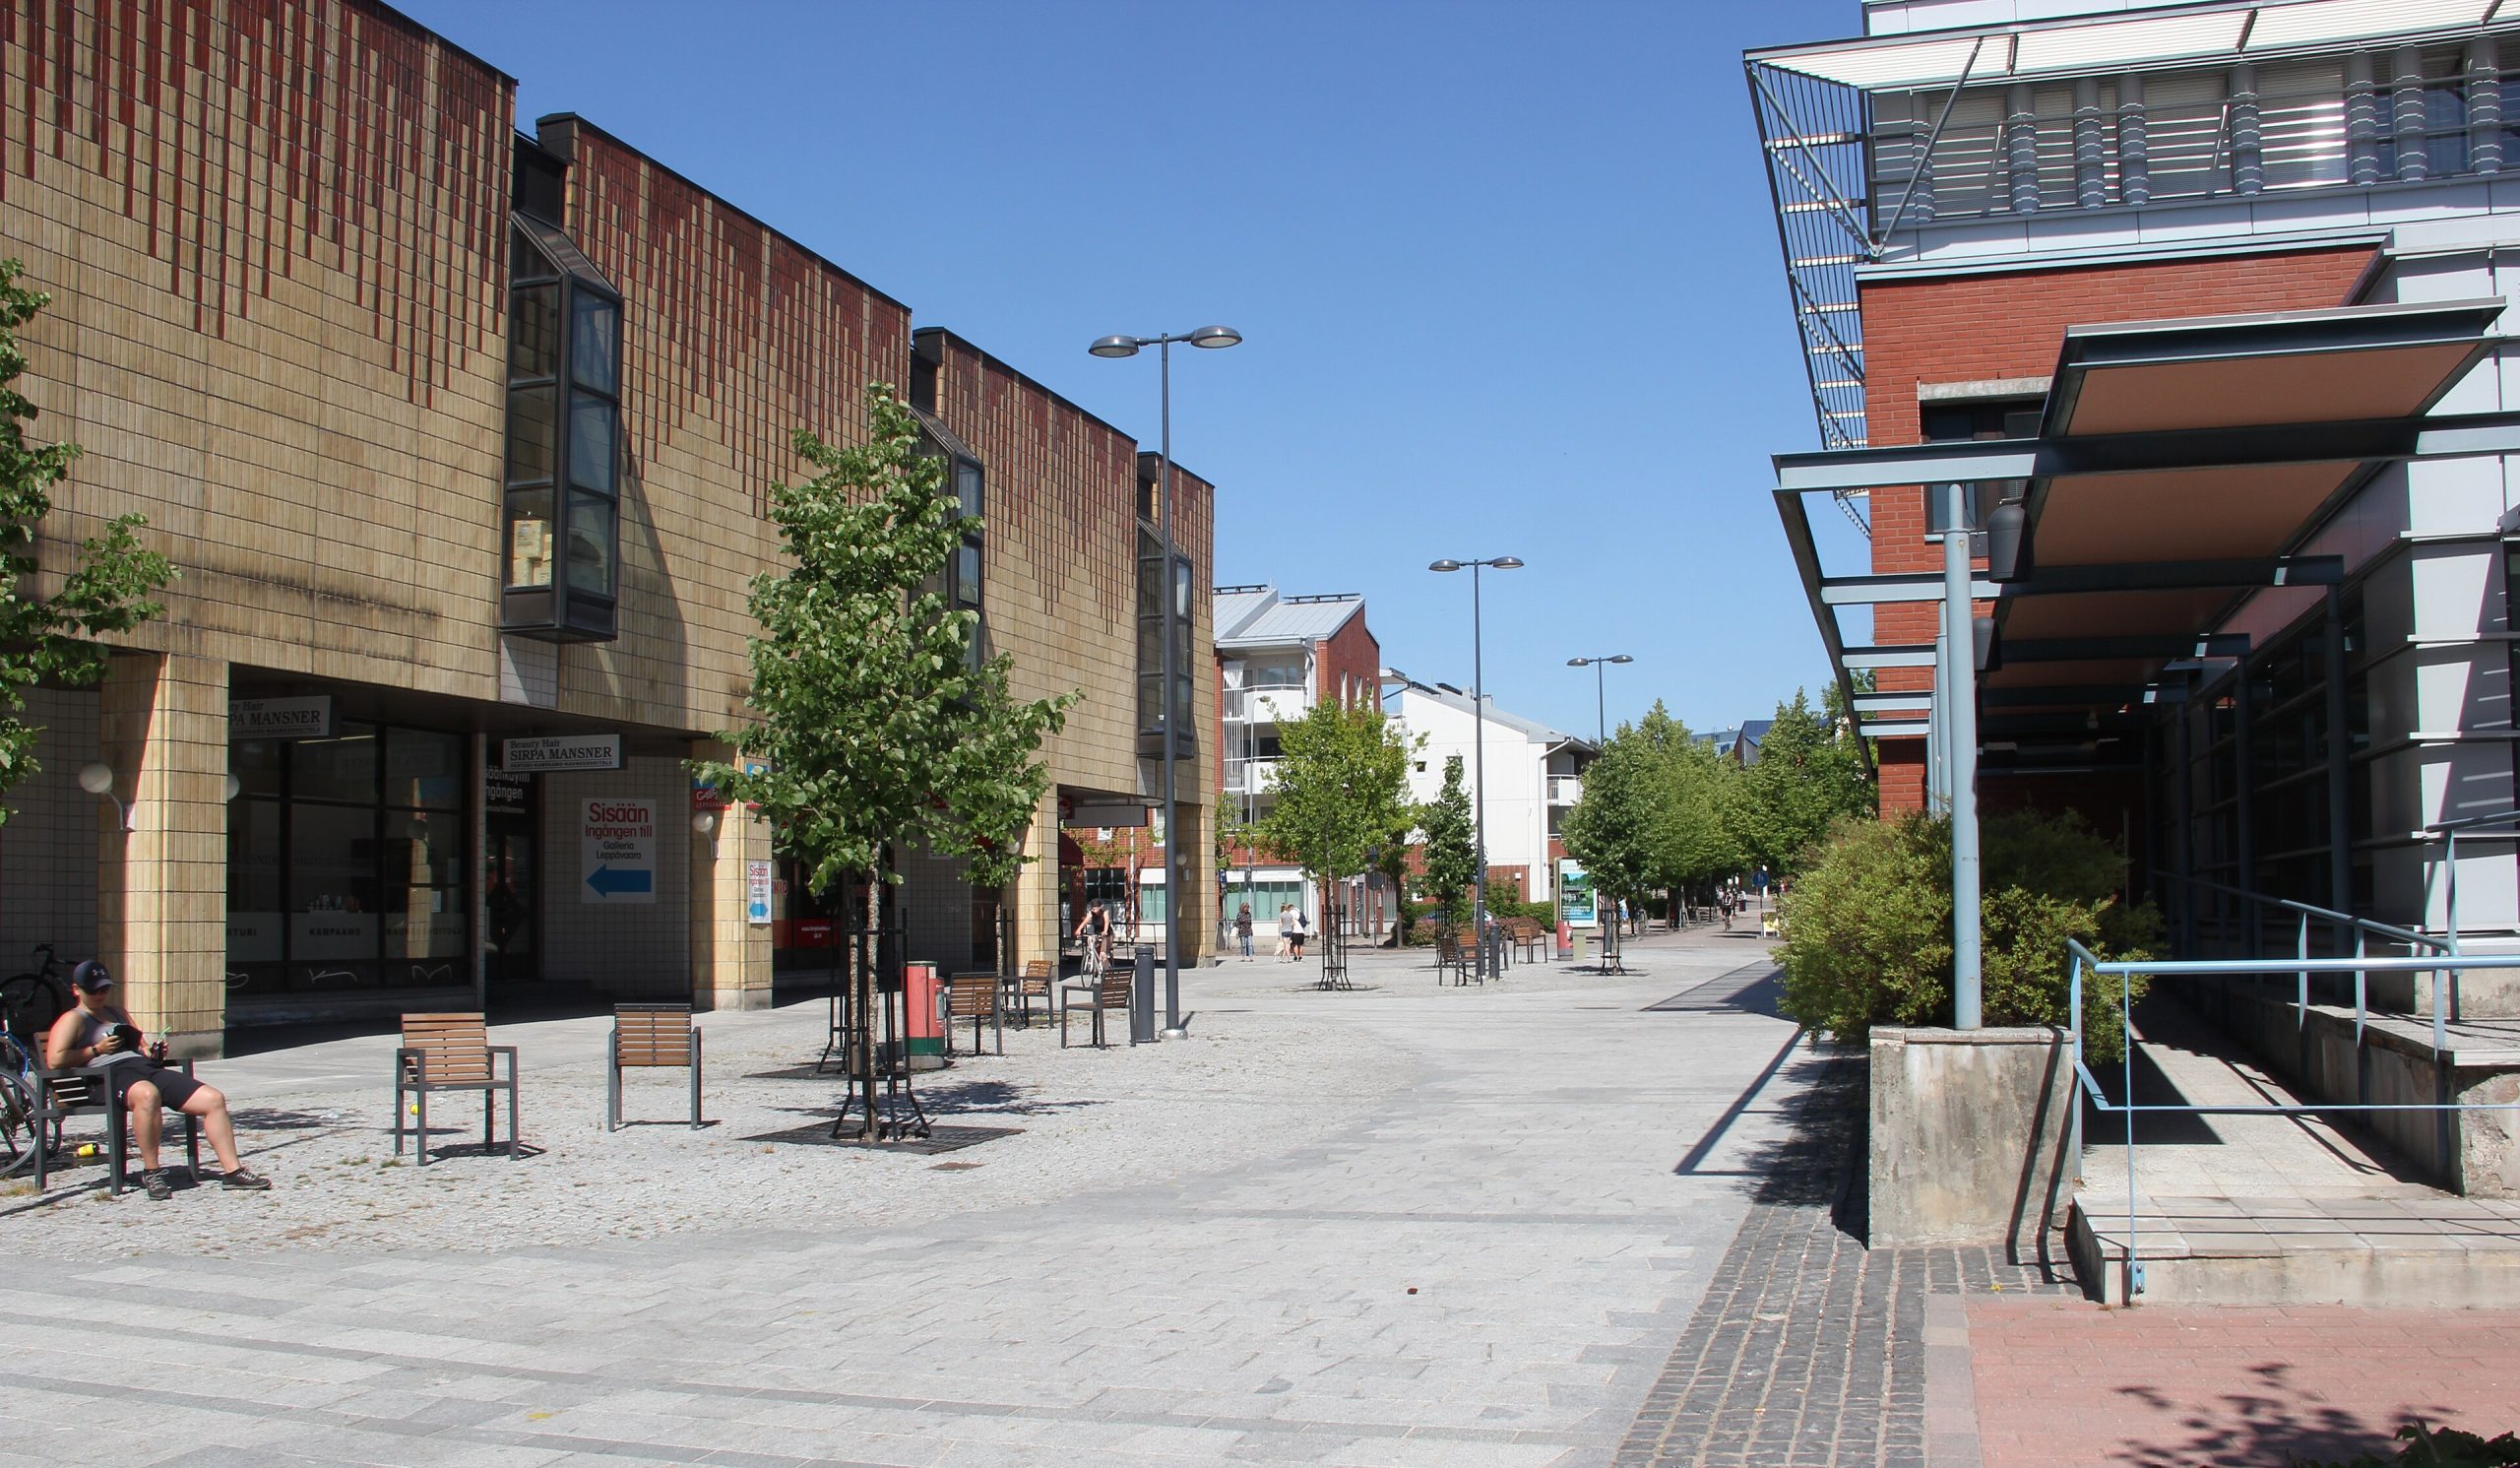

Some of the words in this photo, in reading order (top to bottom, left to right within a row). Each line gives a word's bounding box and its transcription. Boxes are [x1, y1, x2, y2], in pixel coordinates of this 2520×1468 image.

[242, 701, 265, 711] Hair
[250, 710, 321, 726] MANSNER
[510, 740, 540, 750] Beauty
[541, 738, 561, 748] Hair
[510, 749, 545, 761] SIRPA
[549, 746, 612, 760] MANSNER
[486, 782, 524, 801] ngången
[589, 802, 649, 823] Sisään
[585, 823, 637, 841] Ingången
[640, 825, 653, 838] till
[603, 841, 635, 850] Galleria
[596, 850, 642, 861] Leppävaara
[309, 927, 361, 936] KAMPAAMO
